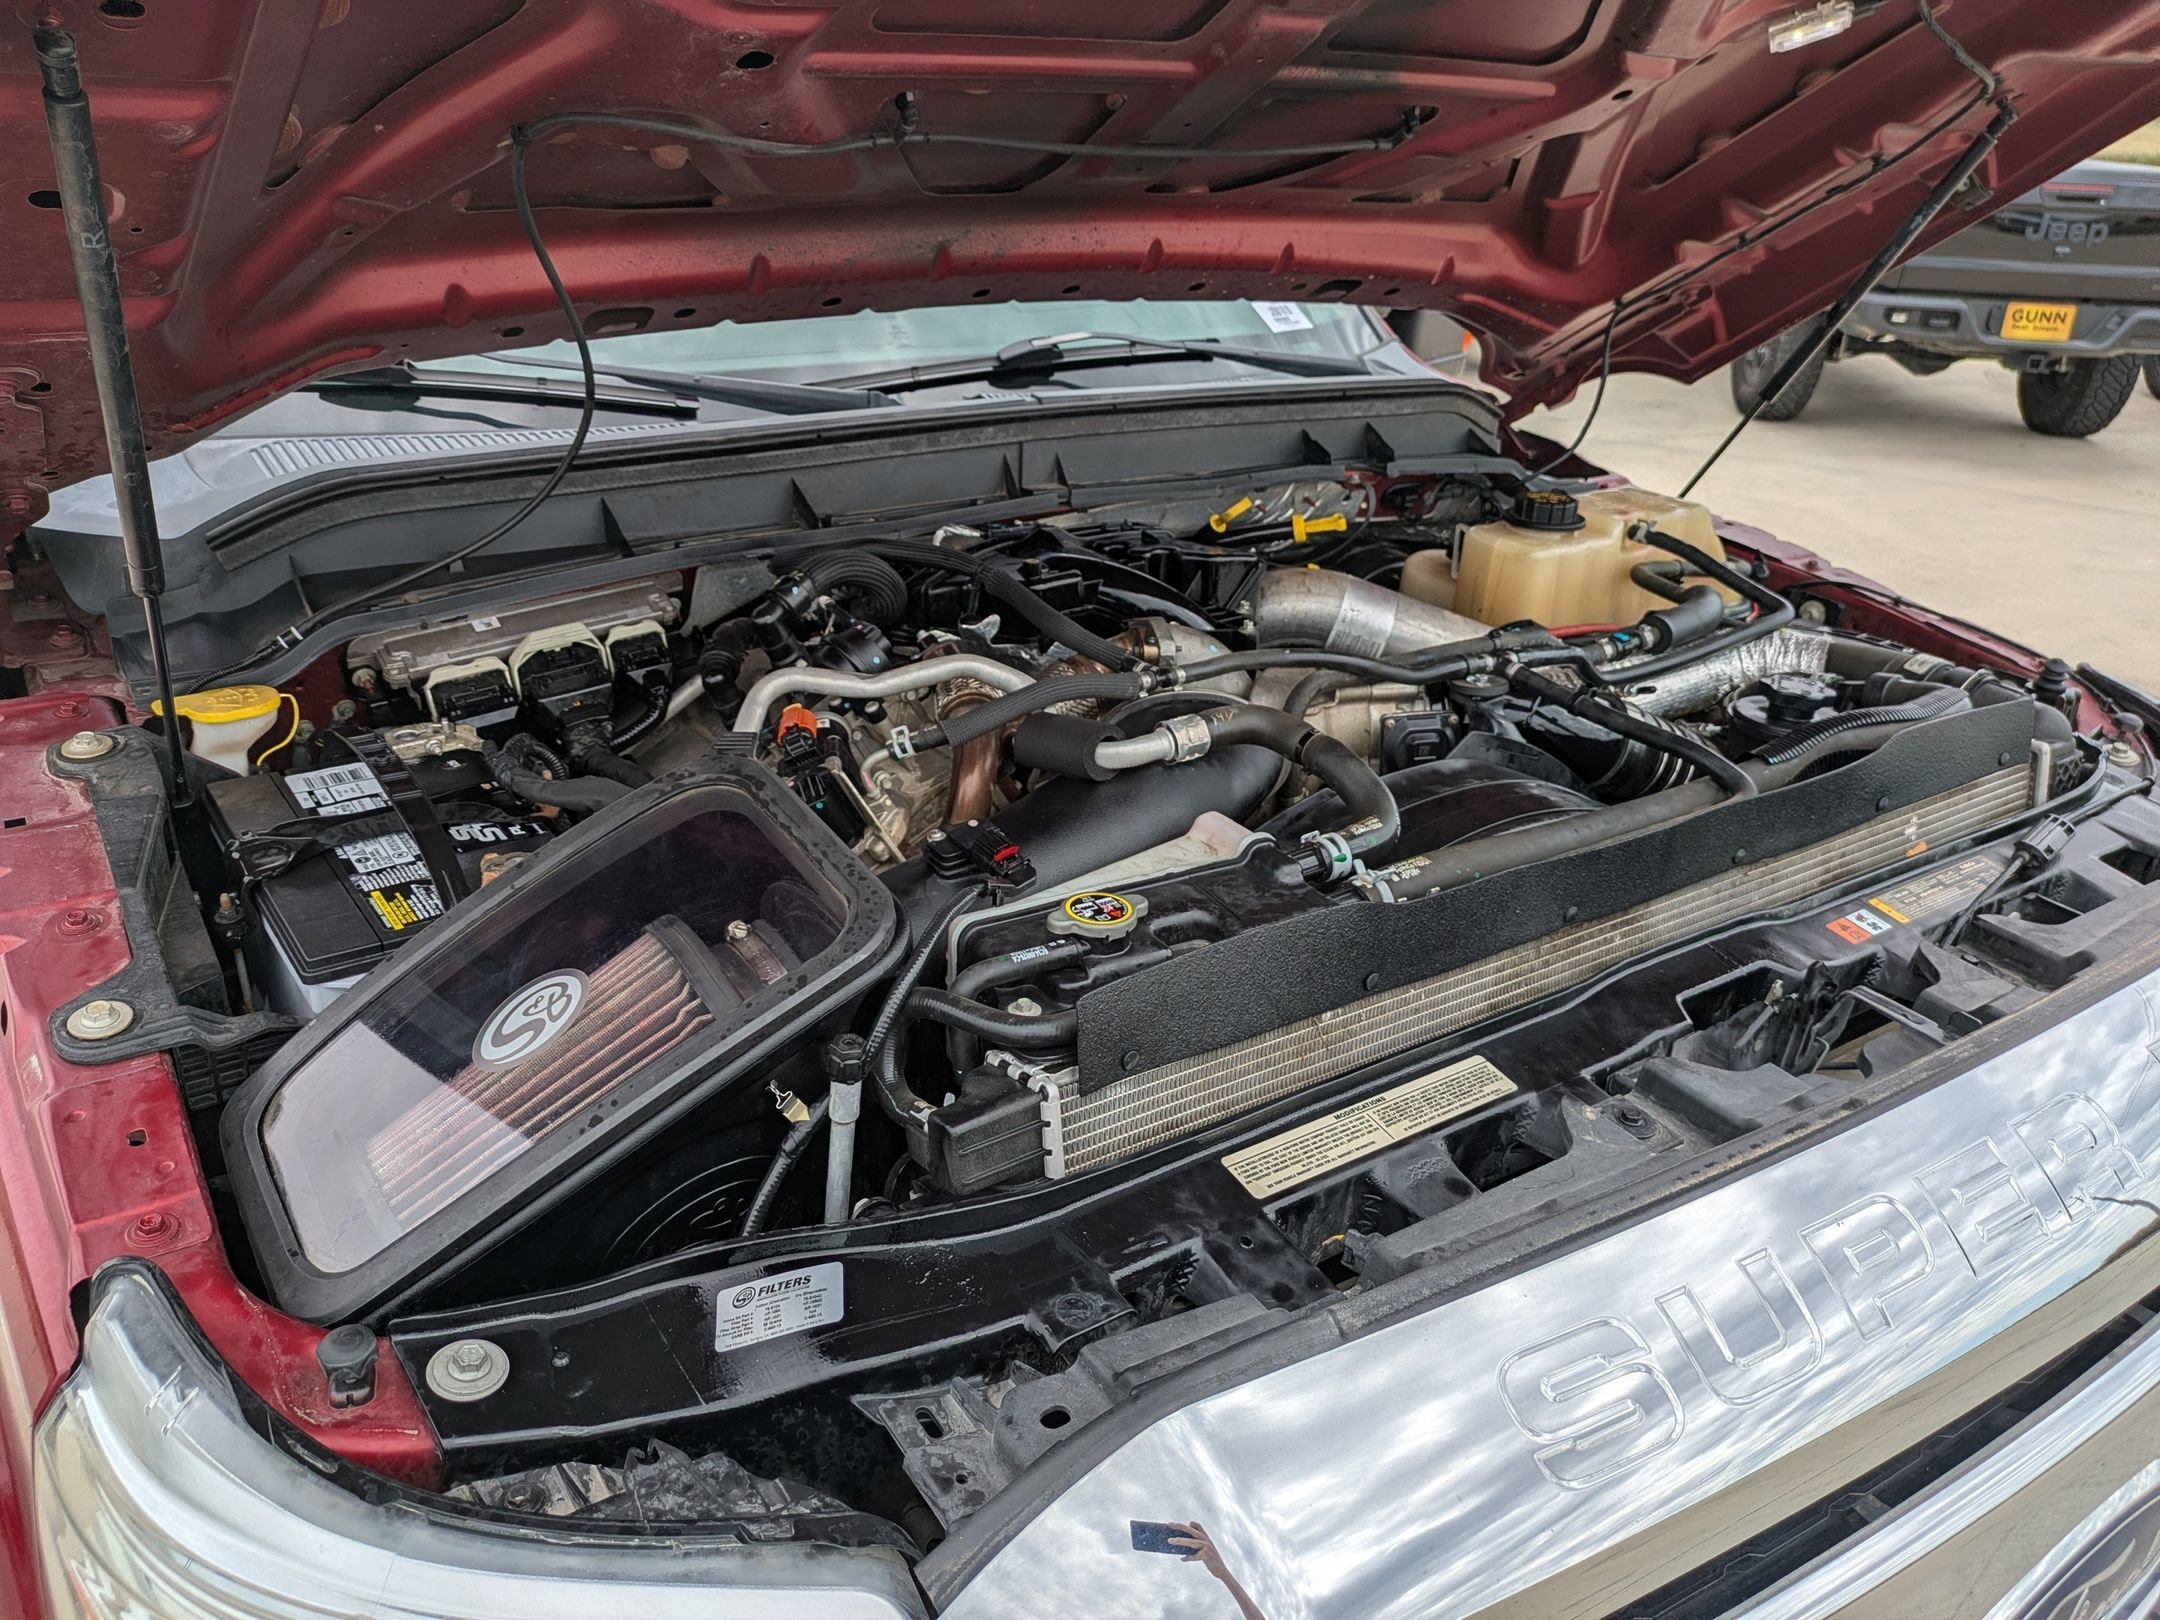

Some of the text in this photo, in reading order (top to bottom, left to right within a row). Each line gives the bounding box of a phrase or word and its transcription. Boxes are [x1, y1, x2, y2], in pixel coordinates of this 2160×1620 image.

[2025, 212, 2109, 247] Jeep
[2011, 306, 2068, 324] GUNN
[1333, 1095, 1387, 1120] MODIFICATIONS
[757, 1274, 812, 1297] FILTERS
[1497, 1091, 2145, 1492] SUPER
